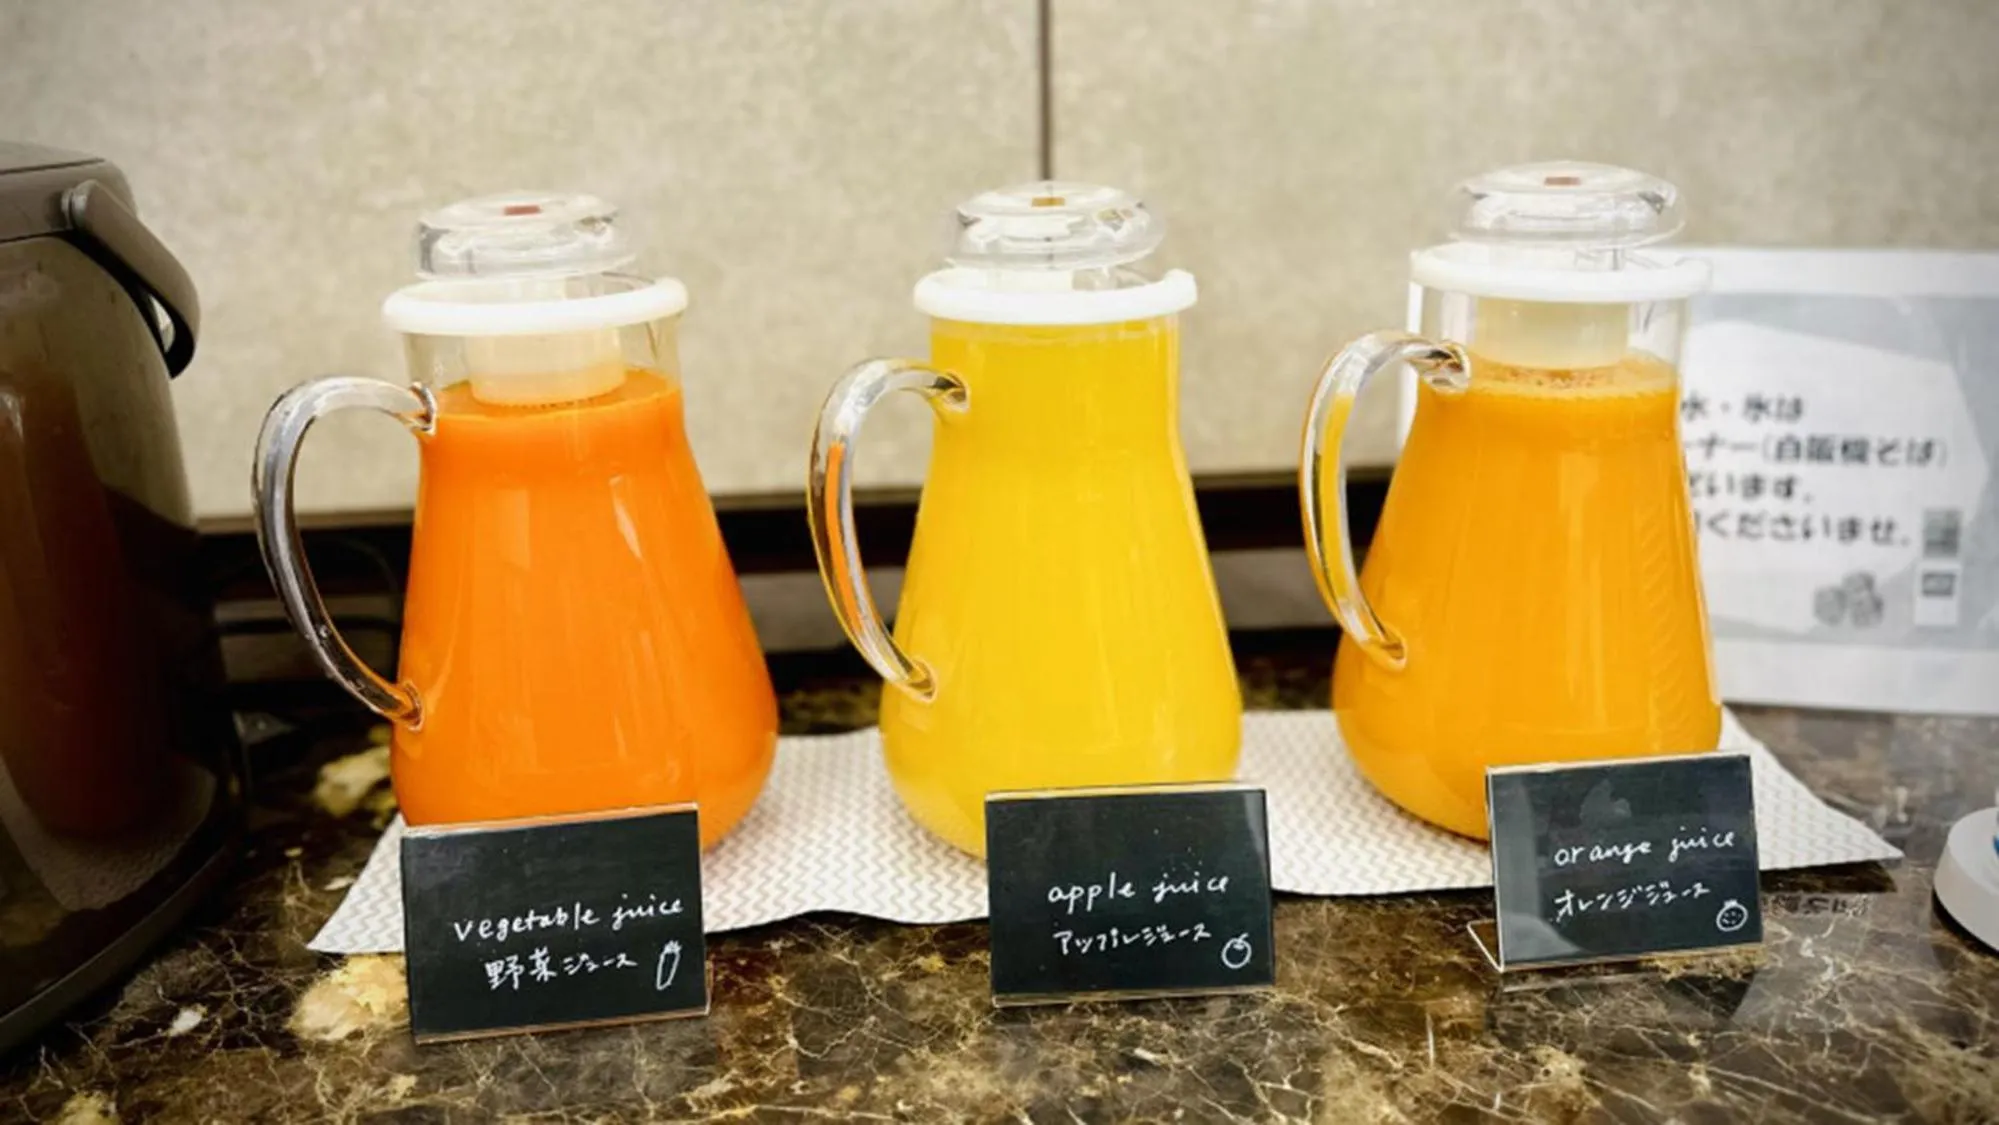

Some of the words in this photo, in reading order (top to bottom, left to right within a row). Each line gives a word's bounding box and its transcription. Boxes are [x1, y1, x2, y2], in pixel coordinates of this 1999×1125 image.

[1694, 510, 1909, 547] くださいませ。
[1554, 841, 1653, 866] orange
[1669, 826, 1735, 862] juice
[1048, 871, 1136, 914] apple
[1153, 871, 1230, 903] juice
[1554, 881, 1711, 922] オレンジジュース
[454, 902, 600, 942] vegetable
[612, 893, 683, 931] juice
[1053, 923, 1212, 955] アップルジュース
[484, 946, 638, 991] 野菜ジュース
